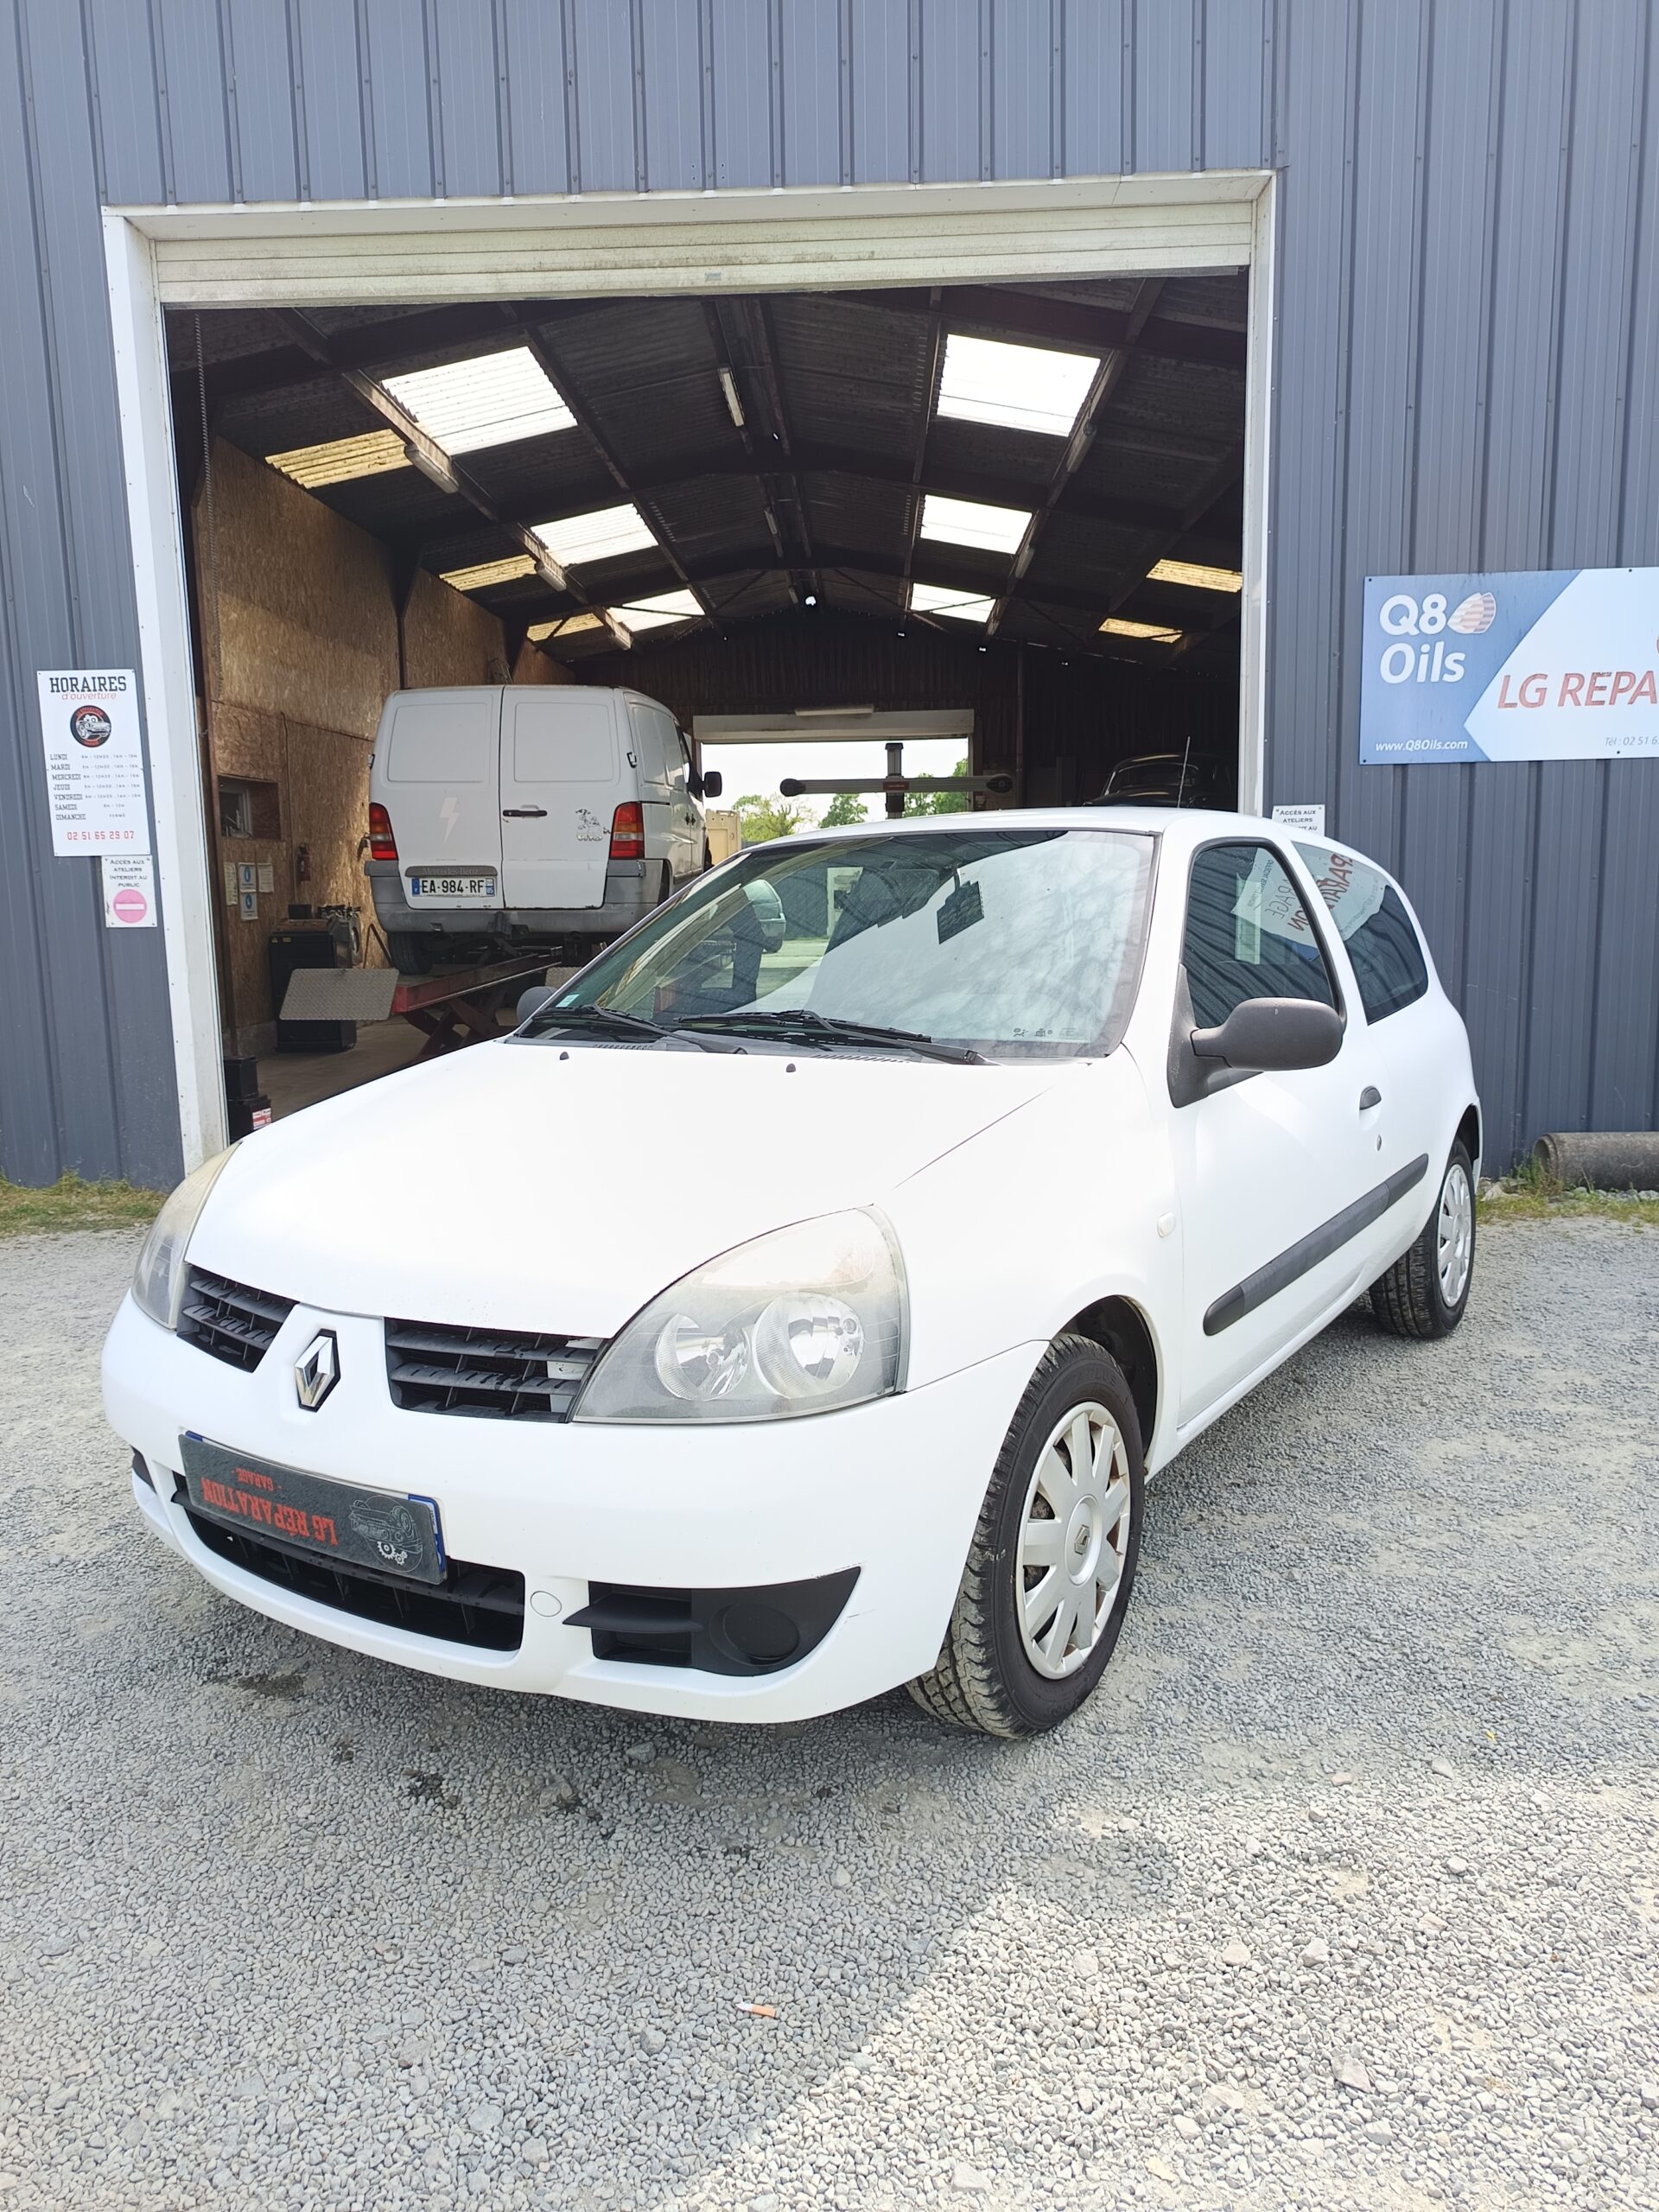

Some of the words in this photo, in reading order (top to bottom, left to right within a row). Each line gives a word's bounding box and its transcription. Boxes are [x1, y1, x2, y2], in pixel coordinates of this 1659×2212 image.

[1379, 593, 1447, 636] Q8
[1380, 640, 1466, 684] Oils
[49, 676, 127, 693] HORAIRES
[1497, 673, 1548, 709] LG
[61, 692, 118, 701] d'ouverture
[1375, 739, 1468, 752] www.Q8Oils.com
[1623, 737, 1636, 746] 02
[1637, 736, 1649, 745] 51
[67, 831, 78, 841] 02
[81, 831, 91, 841] 51
[124, 830, 135, 839] 07
[422, 880, 485, 893] EA-984-RF
[200, 1477, 310, 1537] RÉPARATION
[311, 1514, 339, 1546] LG
